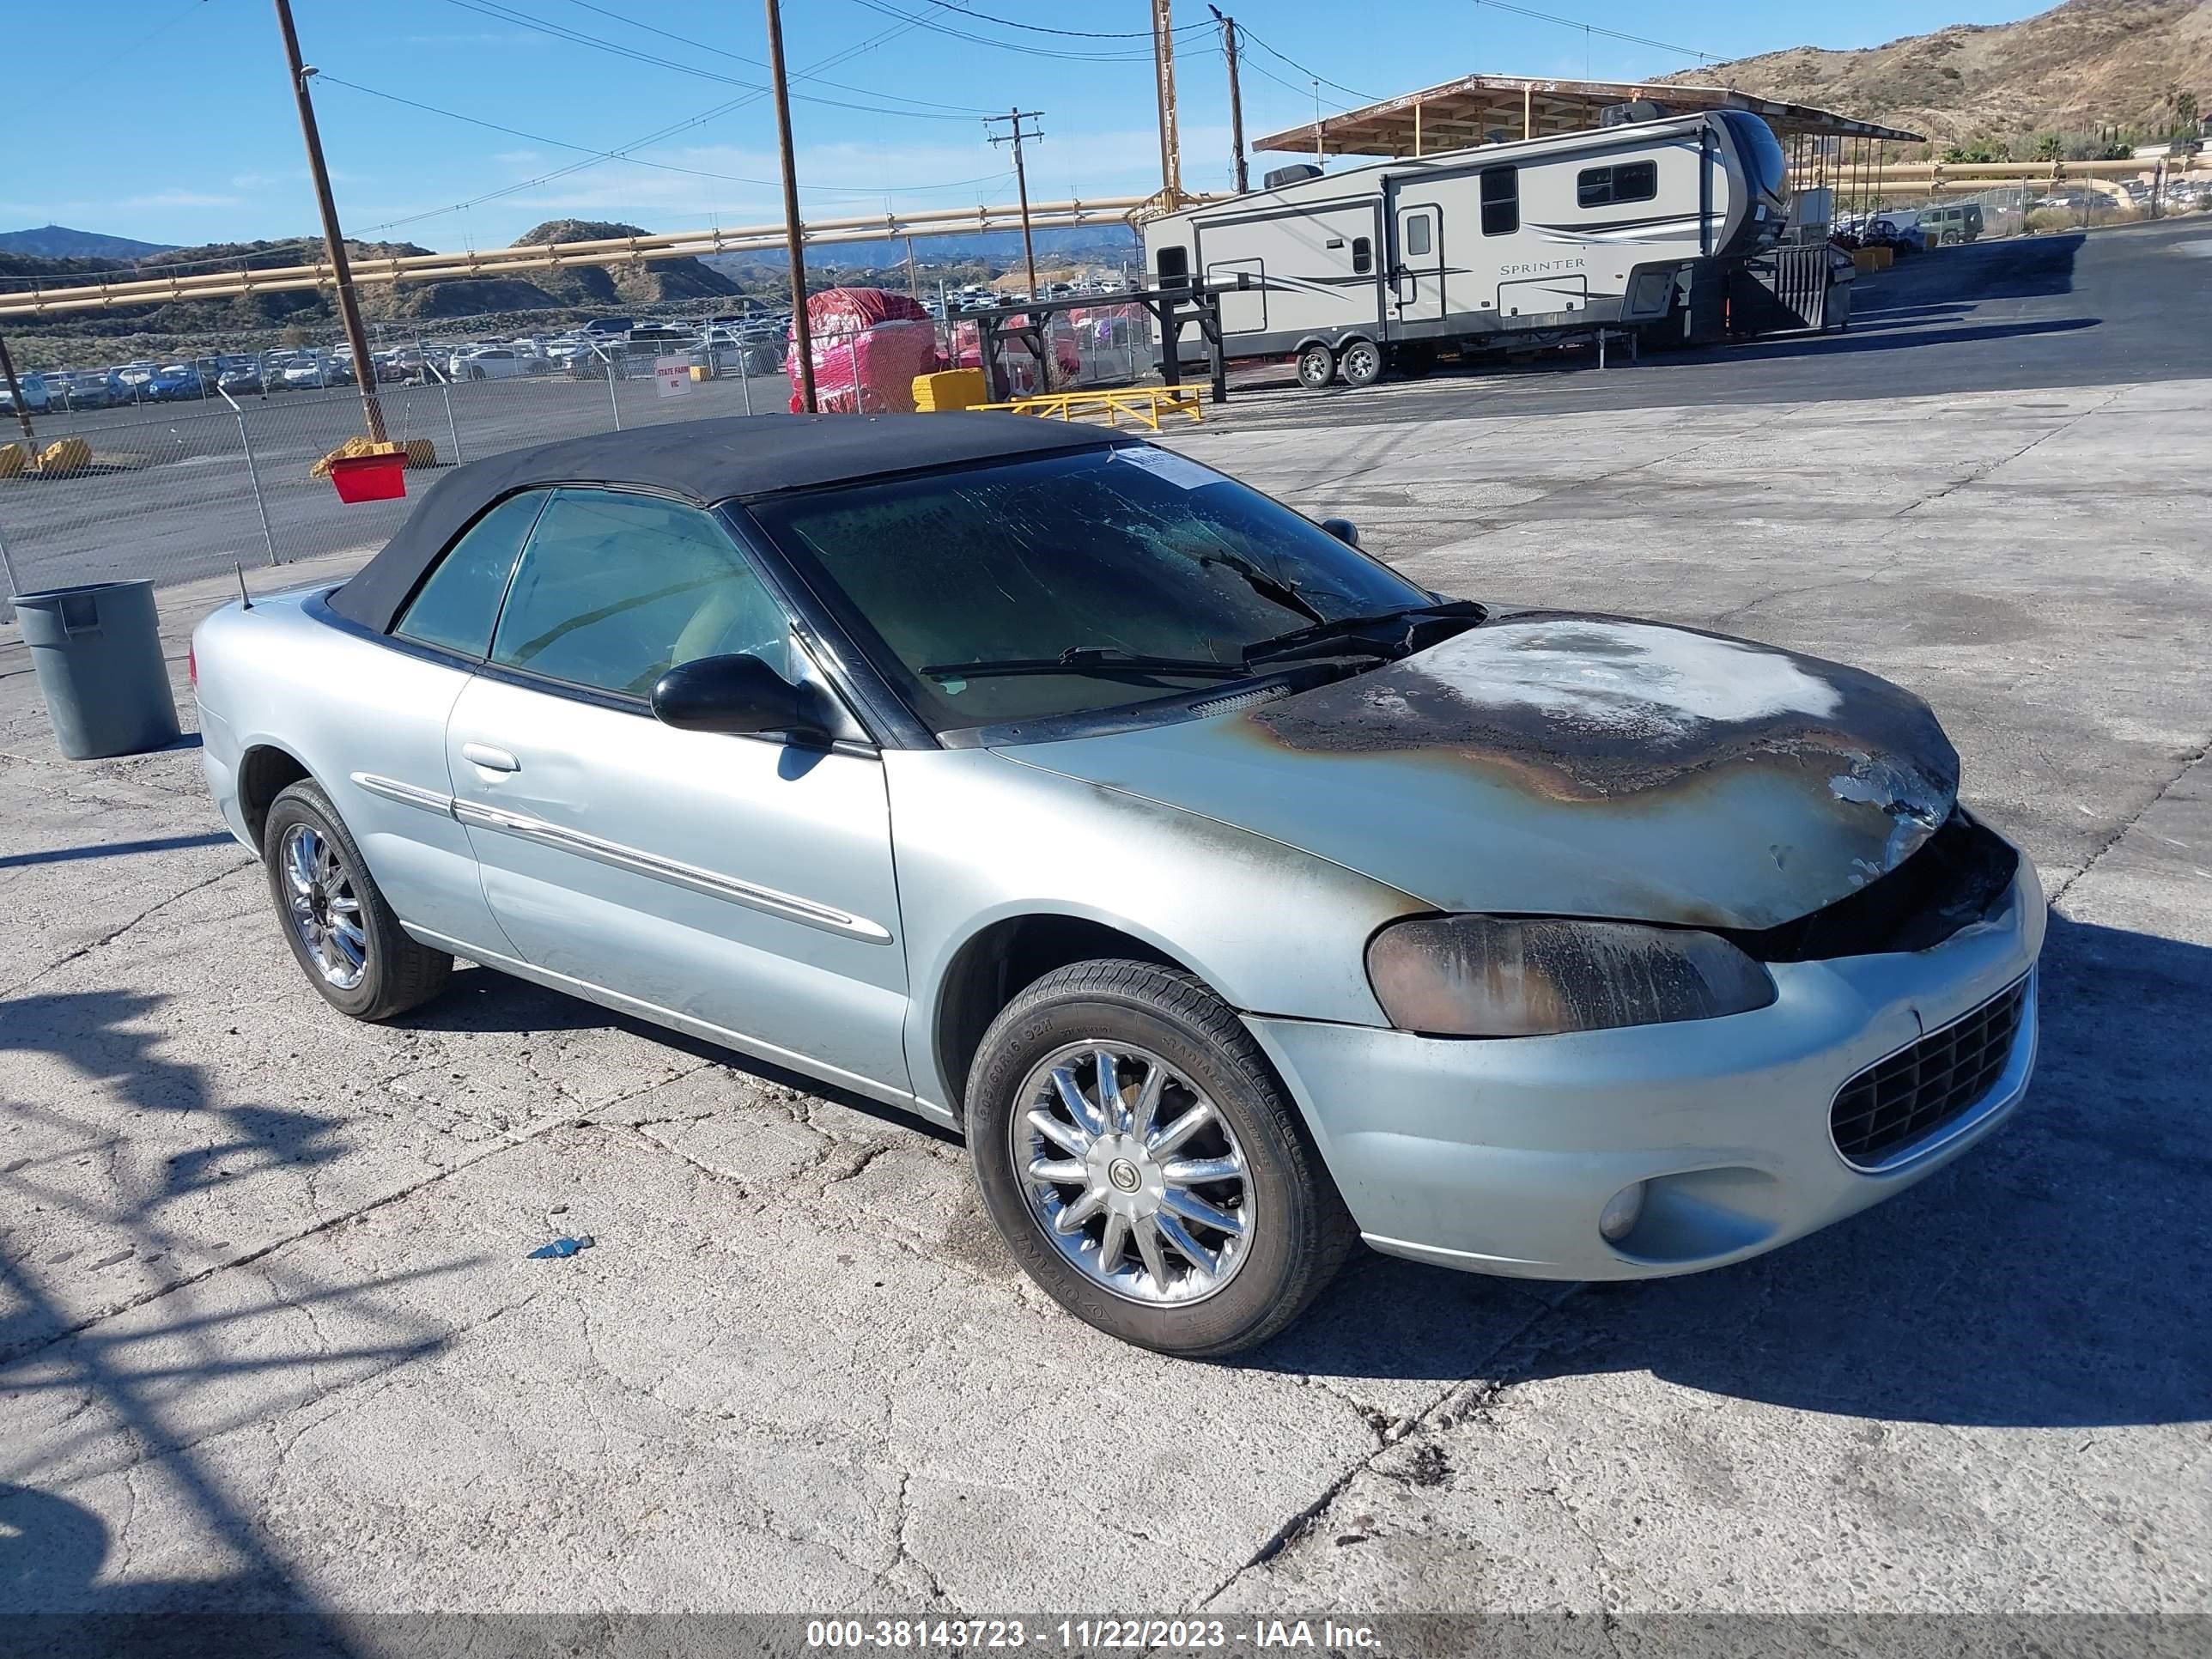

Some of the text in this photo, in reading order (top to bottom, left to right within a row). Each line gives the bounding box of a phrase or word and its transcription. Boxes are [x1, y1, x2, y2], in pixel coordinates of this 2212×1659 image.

[1500, 258, 1585, 276] SPRINTER
[658, 366, 690, 377] STATE FARM
